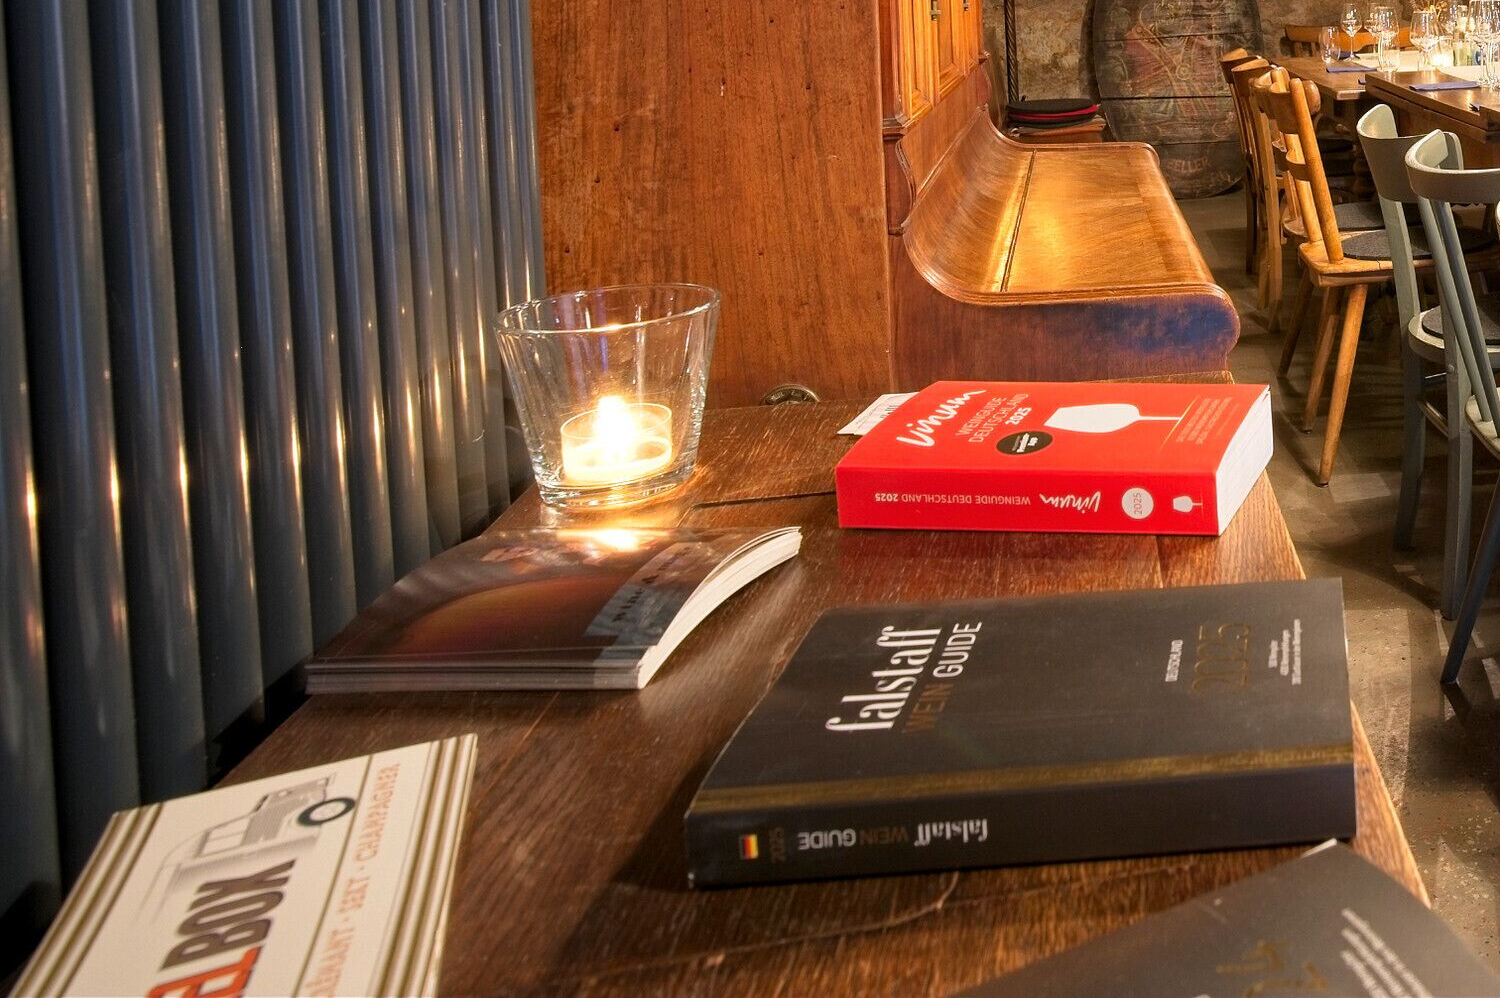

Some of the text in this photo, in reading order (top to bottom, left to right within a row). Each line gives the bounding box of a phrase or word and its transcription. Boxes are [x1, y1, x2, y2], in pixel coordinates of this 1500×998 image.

[955, 397, 1006, 436] WEINGUIDE
[968, 393, 1029, 443] DEUTSCHLAND
[1005, 406, 1033, 425] 2025
[874, 492, 899, 502] 2025
[901, 493, 972, 504] DEUTSCHLAND
[974, 494, 1031, 506] WEINGUIDE
[1132, 491, 1145, 516] 2025
[932, 621, 983, 678] GUIDE
[825, 625, 942, 732] falstaff
[353, 762, 401, 861] CHAMPAGNER
[797, 827, 857, 850] GUIDE
[913, 817, 988, 847] falstaff
